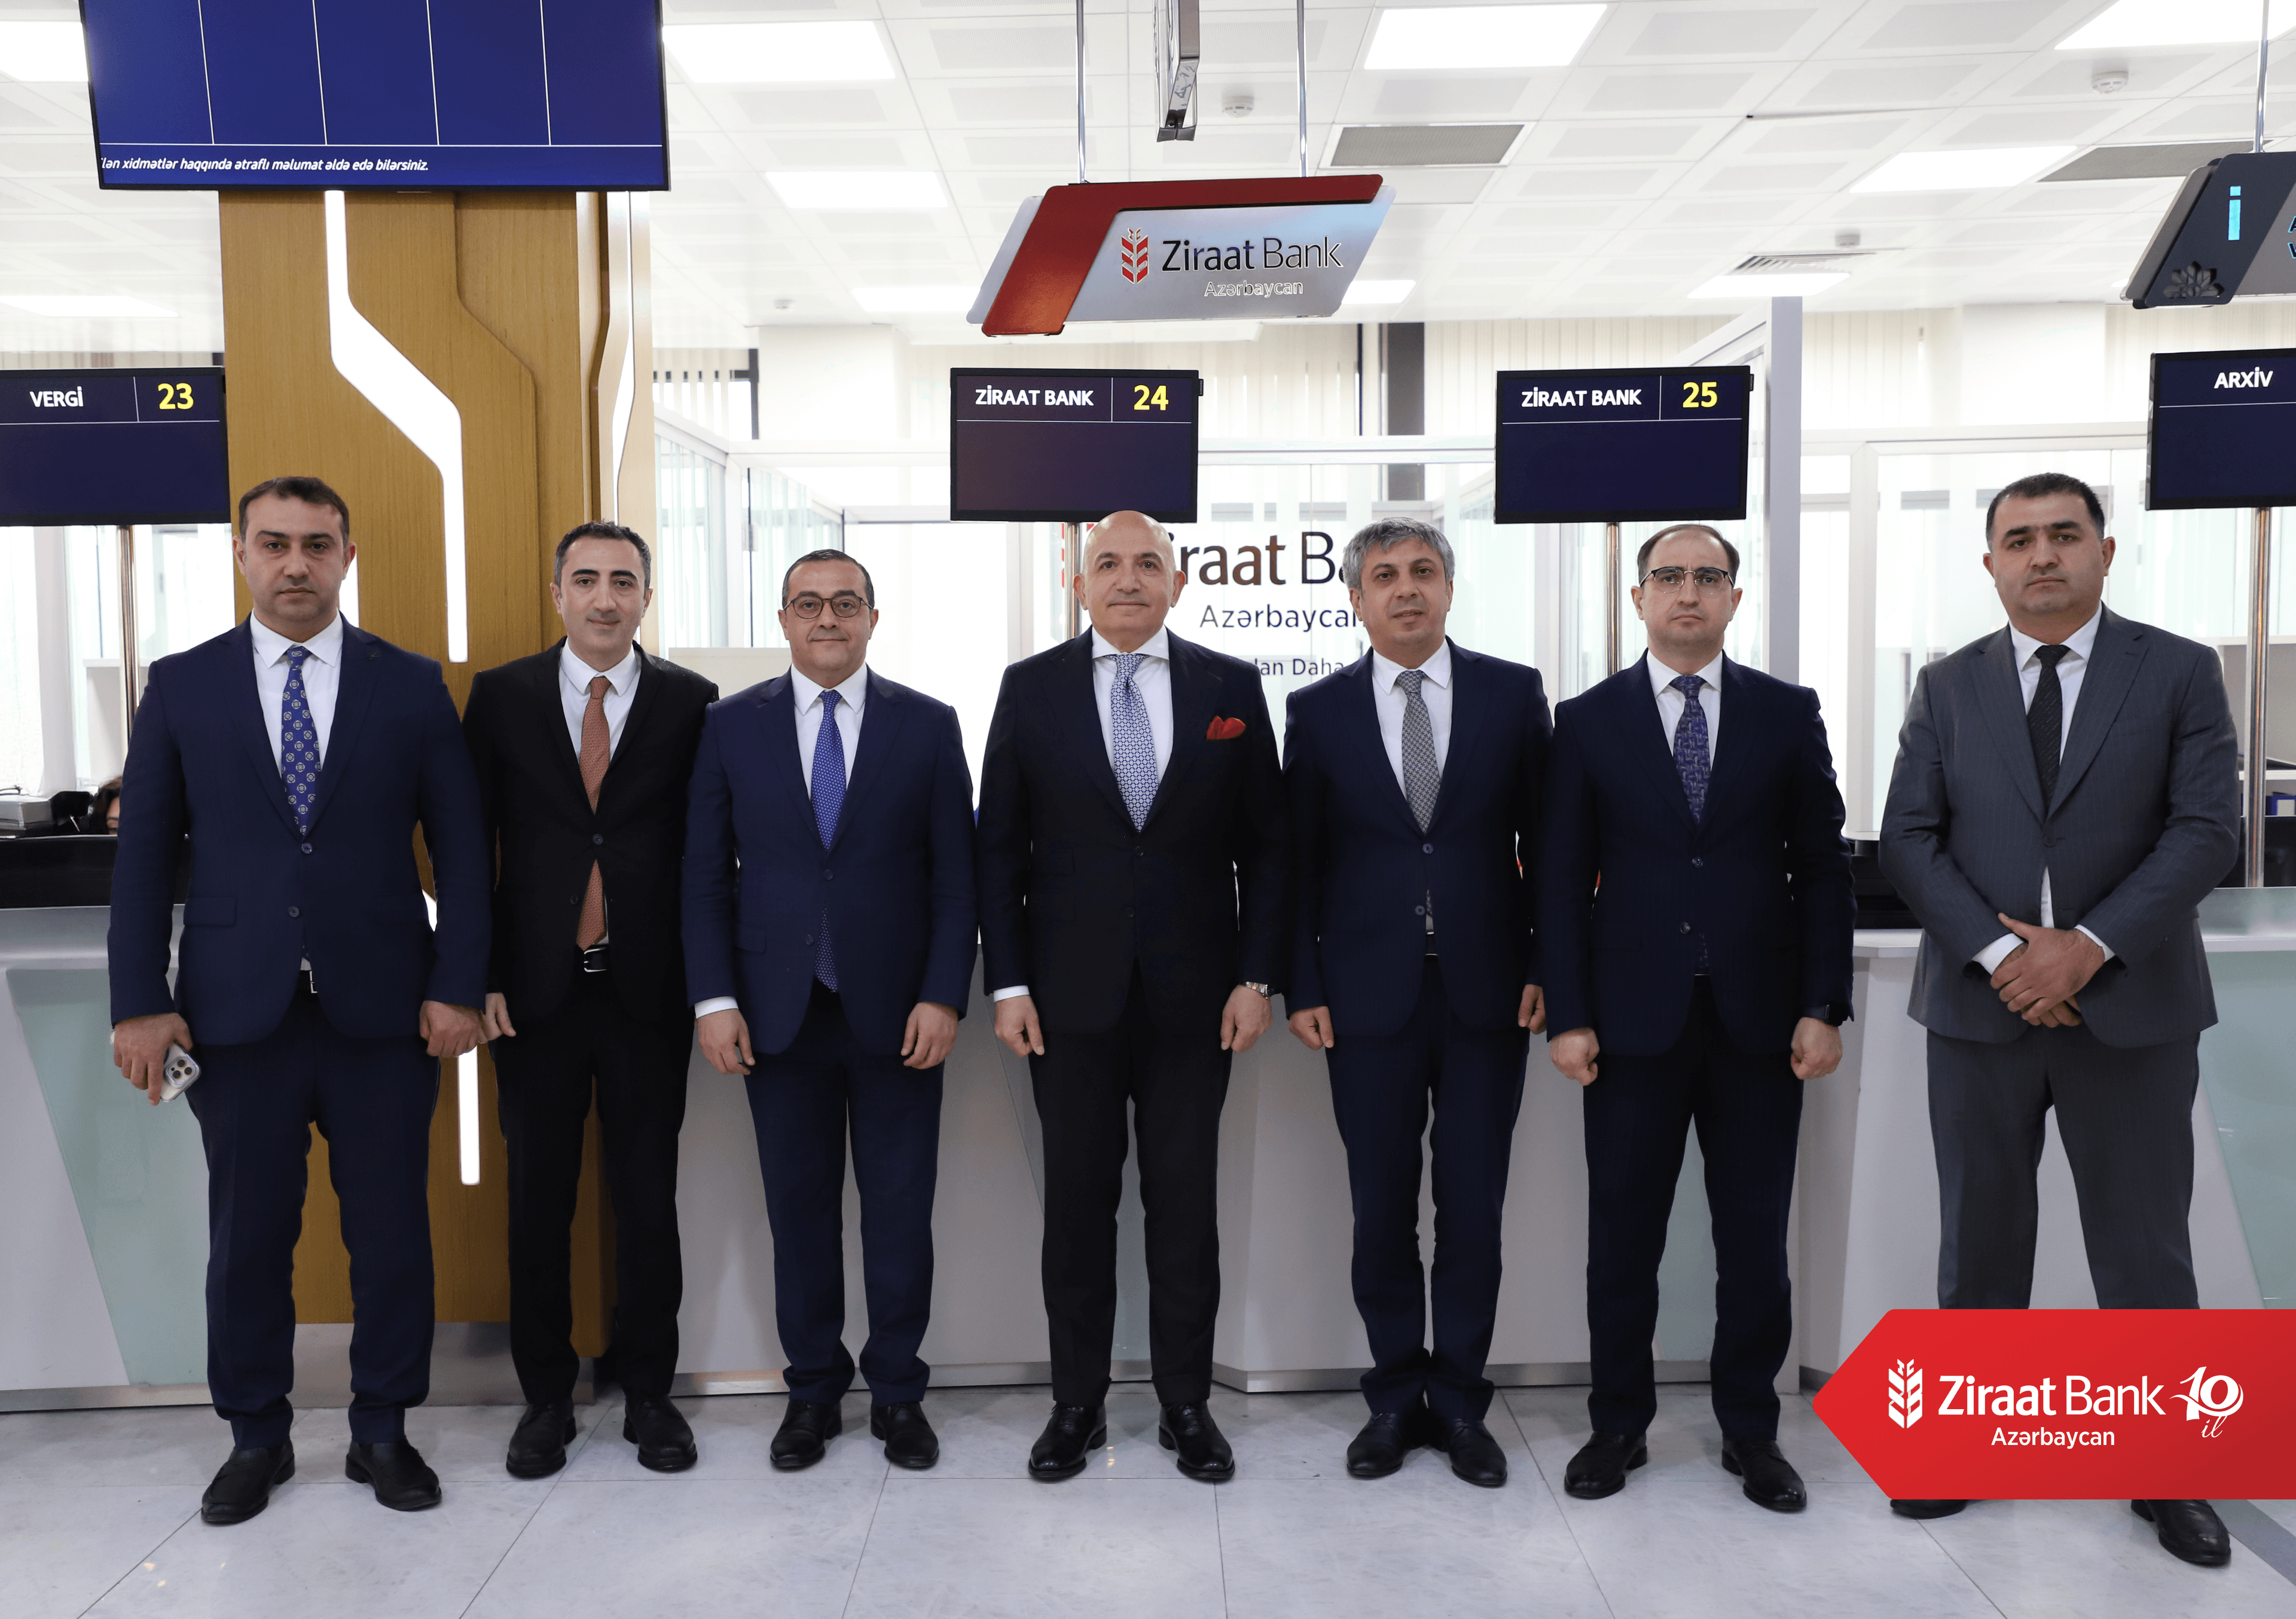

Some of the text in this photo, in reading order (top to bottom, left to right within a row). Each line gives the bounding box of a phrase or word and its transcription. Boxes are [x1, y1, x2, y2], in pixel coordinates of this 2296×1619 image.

[100, 157, 429, 172] lən xidmətlər haqqında ətraflı məlumat əldə edə bilərsiniz.
[1162, 236, 1344, 271] Ziraat Bank
[1204, 280, 1304, 298] Azərbaycan
[2213, 366, 2274, 389] ARXİV
[29, 386, 84, 407] VERGİ
[158, 383, 194, 410] 23
[975, 384, 1094, 406] ZİRAAT BANK
[1134, 384, 1169, 411] 24
[1521, 386, 1642, 407] ZİRAAT BANK
[1683, 381, 1717, 408] 25
[1168, 531, 1286, 586] raat
